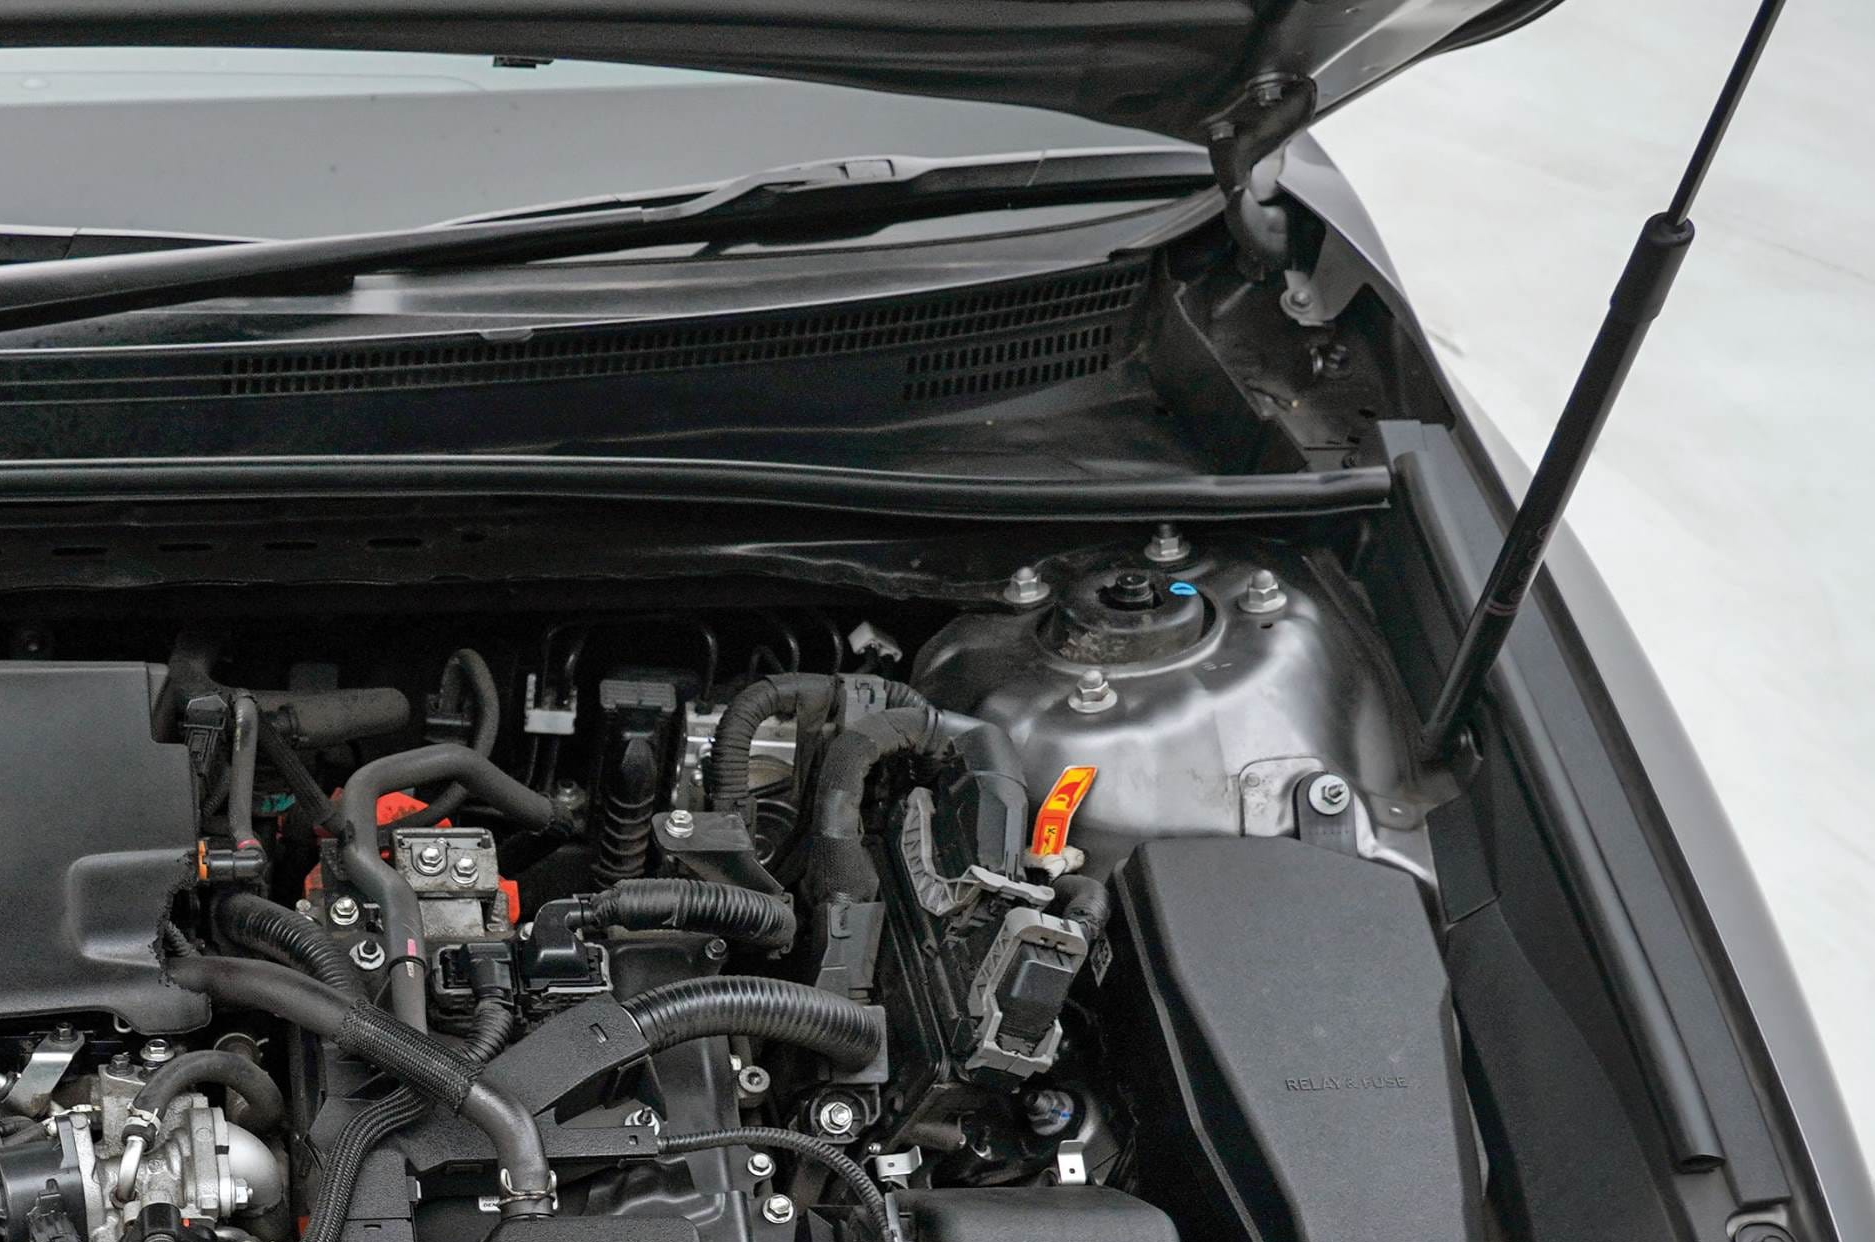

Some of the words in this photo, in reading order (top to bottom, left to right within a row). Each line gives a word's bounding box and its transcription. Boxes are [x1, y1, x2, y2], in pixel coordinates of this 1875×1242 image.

[1284, 1079, 1340, 1091] RELAY
[1345, 1078, 1357, 1089] &
[1361, 1077, 1408, 1089] FUSE
